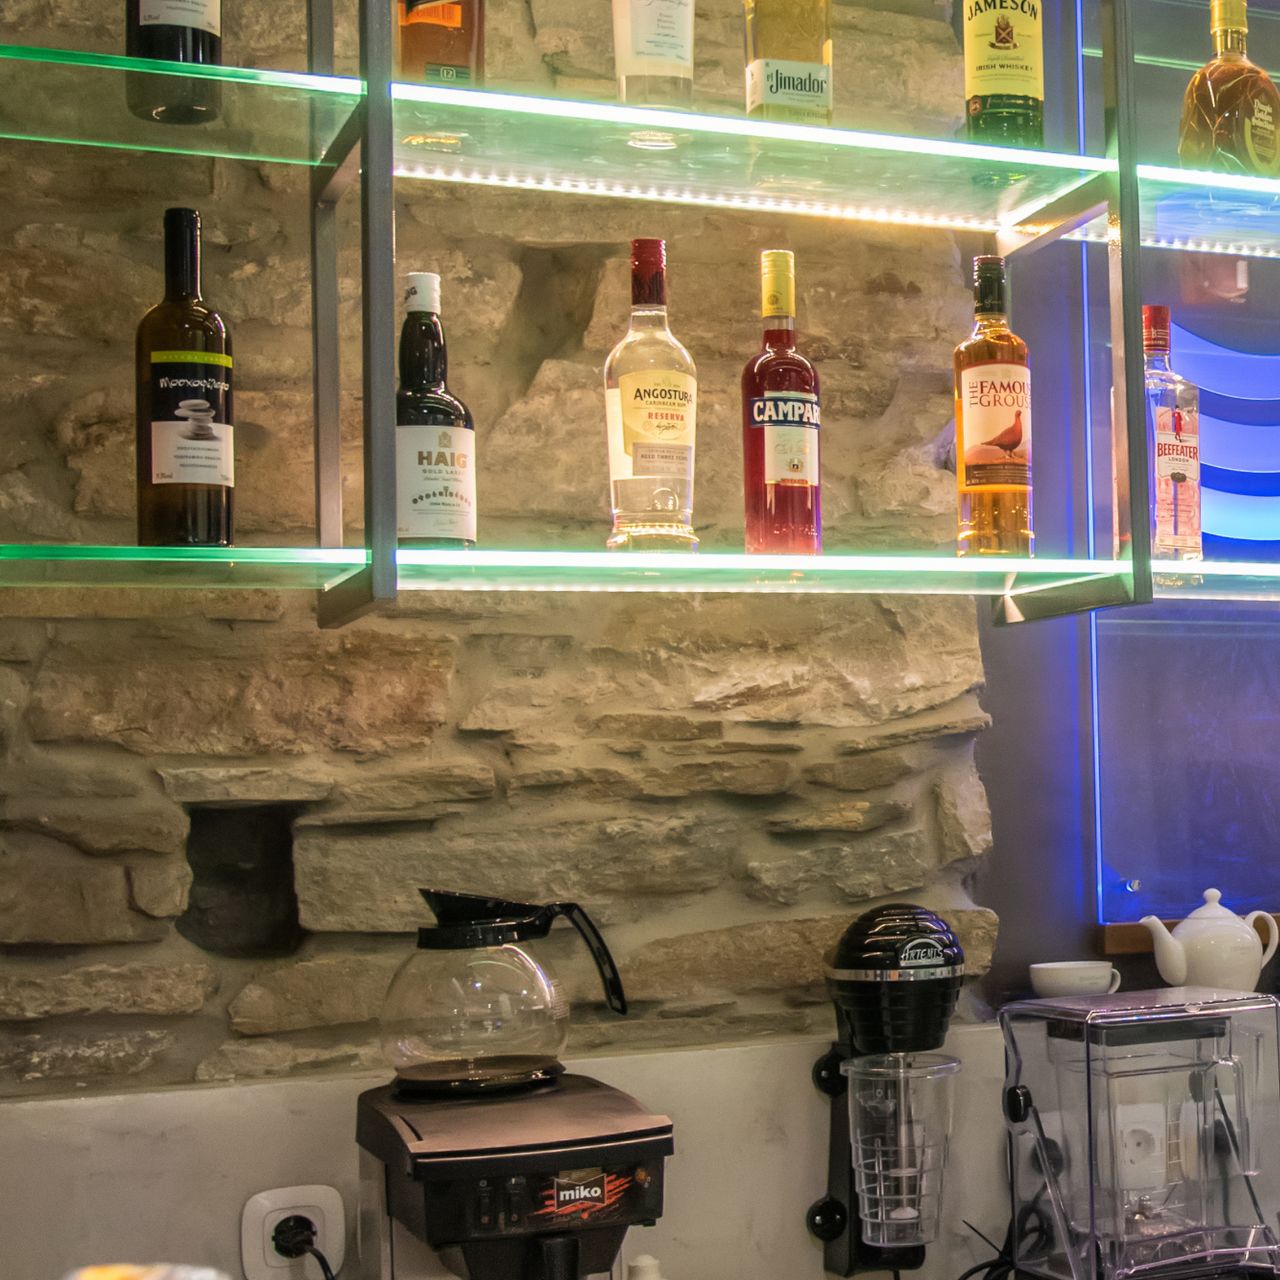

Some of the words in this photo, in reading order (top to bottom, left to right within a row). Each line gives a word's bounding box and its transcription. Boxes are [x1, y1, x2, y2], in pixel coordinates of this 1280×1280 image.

[769, 68, 827, 94] Jimador
[633, 387, 694, 404] ANGOSTURA
[968, 380, 979, 408] THE
[979, 394, 1031, 408] GROUS
[647, 411, 685, 421] RESERVA
[752, 400, 821, 425] CAMPAR
[417, 450, 468, 469] HAIG
[1157, 442, 1199, 462] BEEFEATER
[900, 947, 945, 962] ARTEMIS
[559, 1185, 602, 1201] miko
